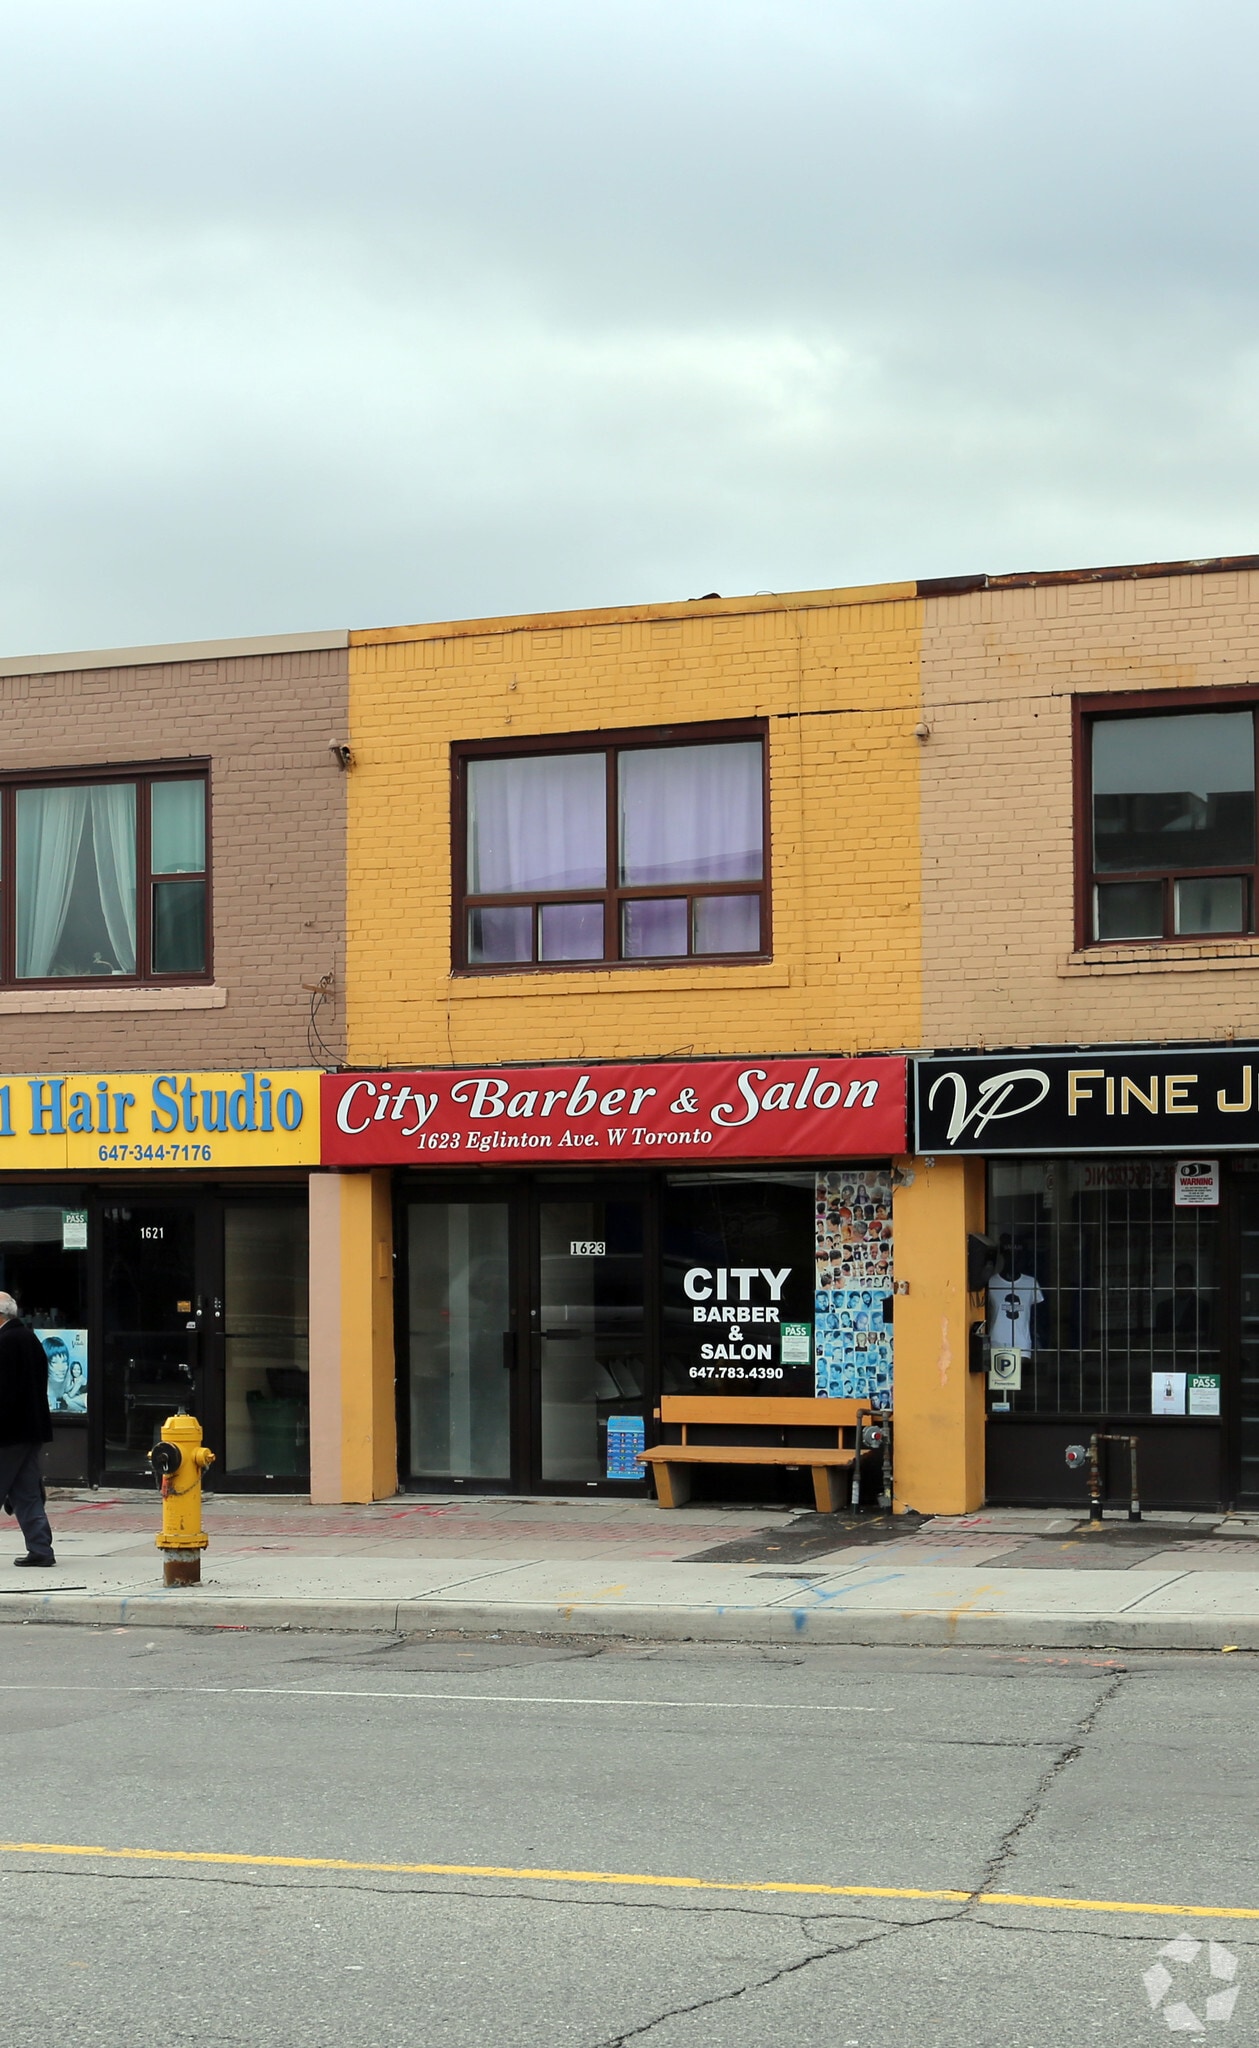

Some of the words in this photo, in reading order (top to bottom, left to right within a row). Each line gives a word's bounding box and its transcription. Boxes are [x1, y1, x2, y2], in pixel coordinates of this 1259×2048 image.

[1067, 1069, 1199, 1116] FINE
[1217, 1065, 1259, 1112] J
[28, 1079, 136, 1136] Hair
[151, 1072, 304, 1133] Studio
[336, 1079, 439, 1136] City
[451, 1075, 657, 1118] Barber
[669, 1087, 700, 1115] &
[710, 1067, 880, 1127] Salon
[417, 1132, 461, 1150] 1623
[465, 1130, 553, 1152] Eglinton
[558, 1129, 600, 1148] Ave.
[607, 1128, 628, 1147] W
[632, 1127, 713, 1146] Toronto
[98, 1144, 212, 1162] 647-344-7176
[1180, 1178, 1213, 1186] WARNING
[66, 1215, 84, 1223] PASS
[140, 1227, 164, 1239] 1621
[571, 1242, 605, 1255] 1623
[683, 1267, 792, 1301] CITY
[693, 1306, 780, 1323] BARBER
[728, 1325, 744, 1341] &
[785, 1327, 807, 1336] PASS
[700, 1344, 772, 1360] SALON
[689, 1367, 784, 1379] 647.783.4390
[1193, 1379, 1216, 1388] PASS
